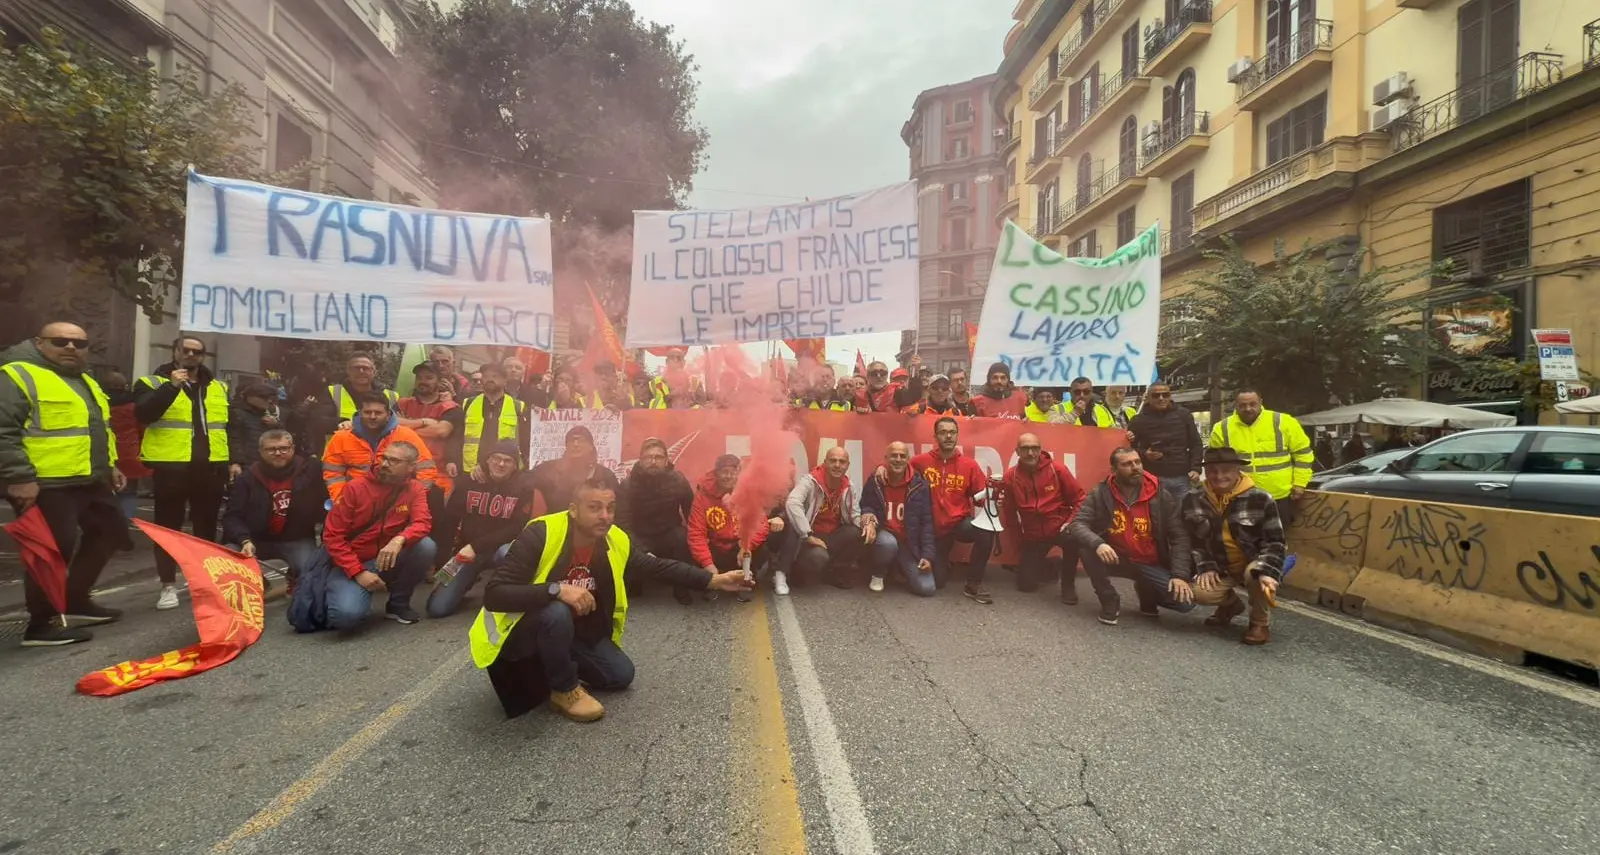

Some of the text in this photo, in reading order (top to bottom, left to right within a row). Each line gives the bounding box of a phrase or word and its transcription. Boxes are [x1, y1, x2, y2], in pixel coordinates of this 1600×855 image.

[204, 180, 532, 284] TRASNOVA
[668, 197, 853, 243] STELLANTIS
[643, 223, 918, 280] IL COLOSSO FRANCESE
[690, 268, 883, 315] CHE CHIUDE
[1009, 280, 1146, 316] CASSINO
[190, 283, 389, 338] POMIGLIANO
[432, 298, 553, 349] D'ARCO
[680, 316, 712, 344] LE
[1009, 310, 1121, 344] LAVORO
